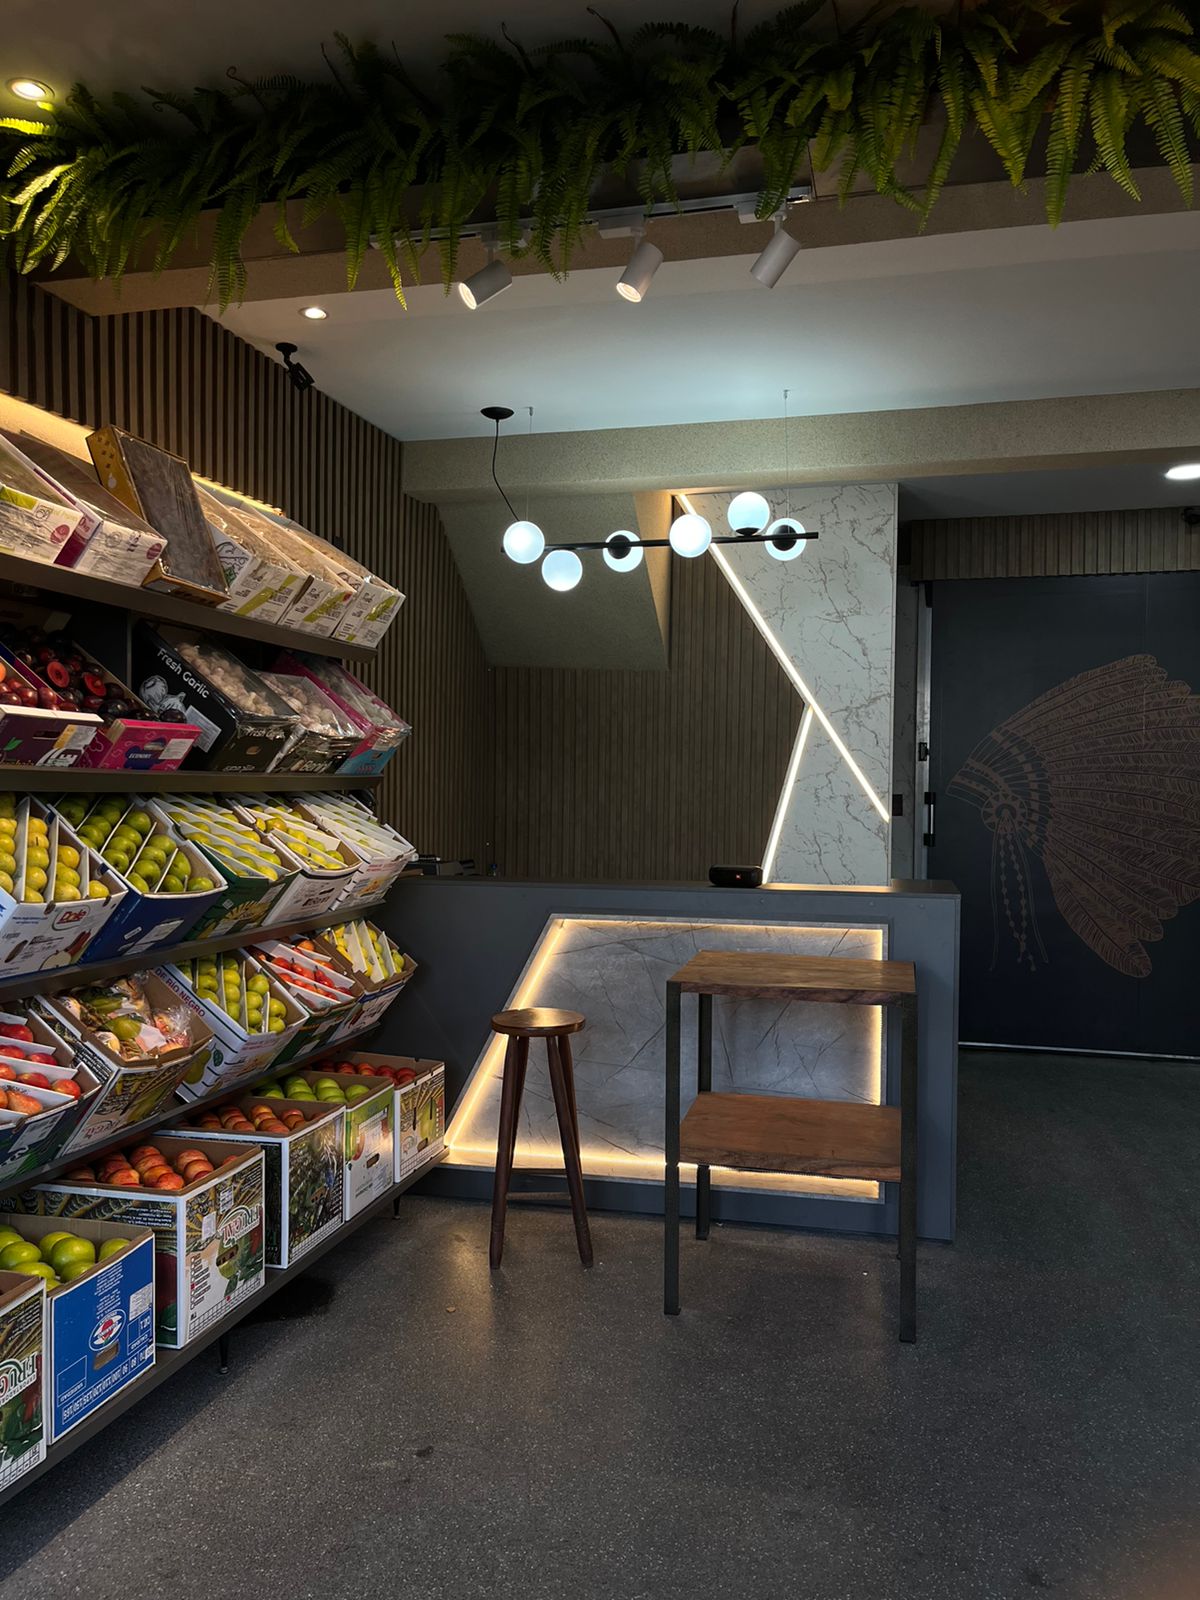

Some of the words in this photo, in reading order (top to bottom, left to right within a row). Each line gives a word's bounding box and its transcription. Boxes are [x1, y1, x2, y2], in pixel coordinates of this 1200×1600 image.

[157, 648, 182, 675] Fresh
[182, 671, 210, 698] Garlic
[179, 991, 205, 1017] NEGRO
[0, 1351, 38, 1398] FRUG
